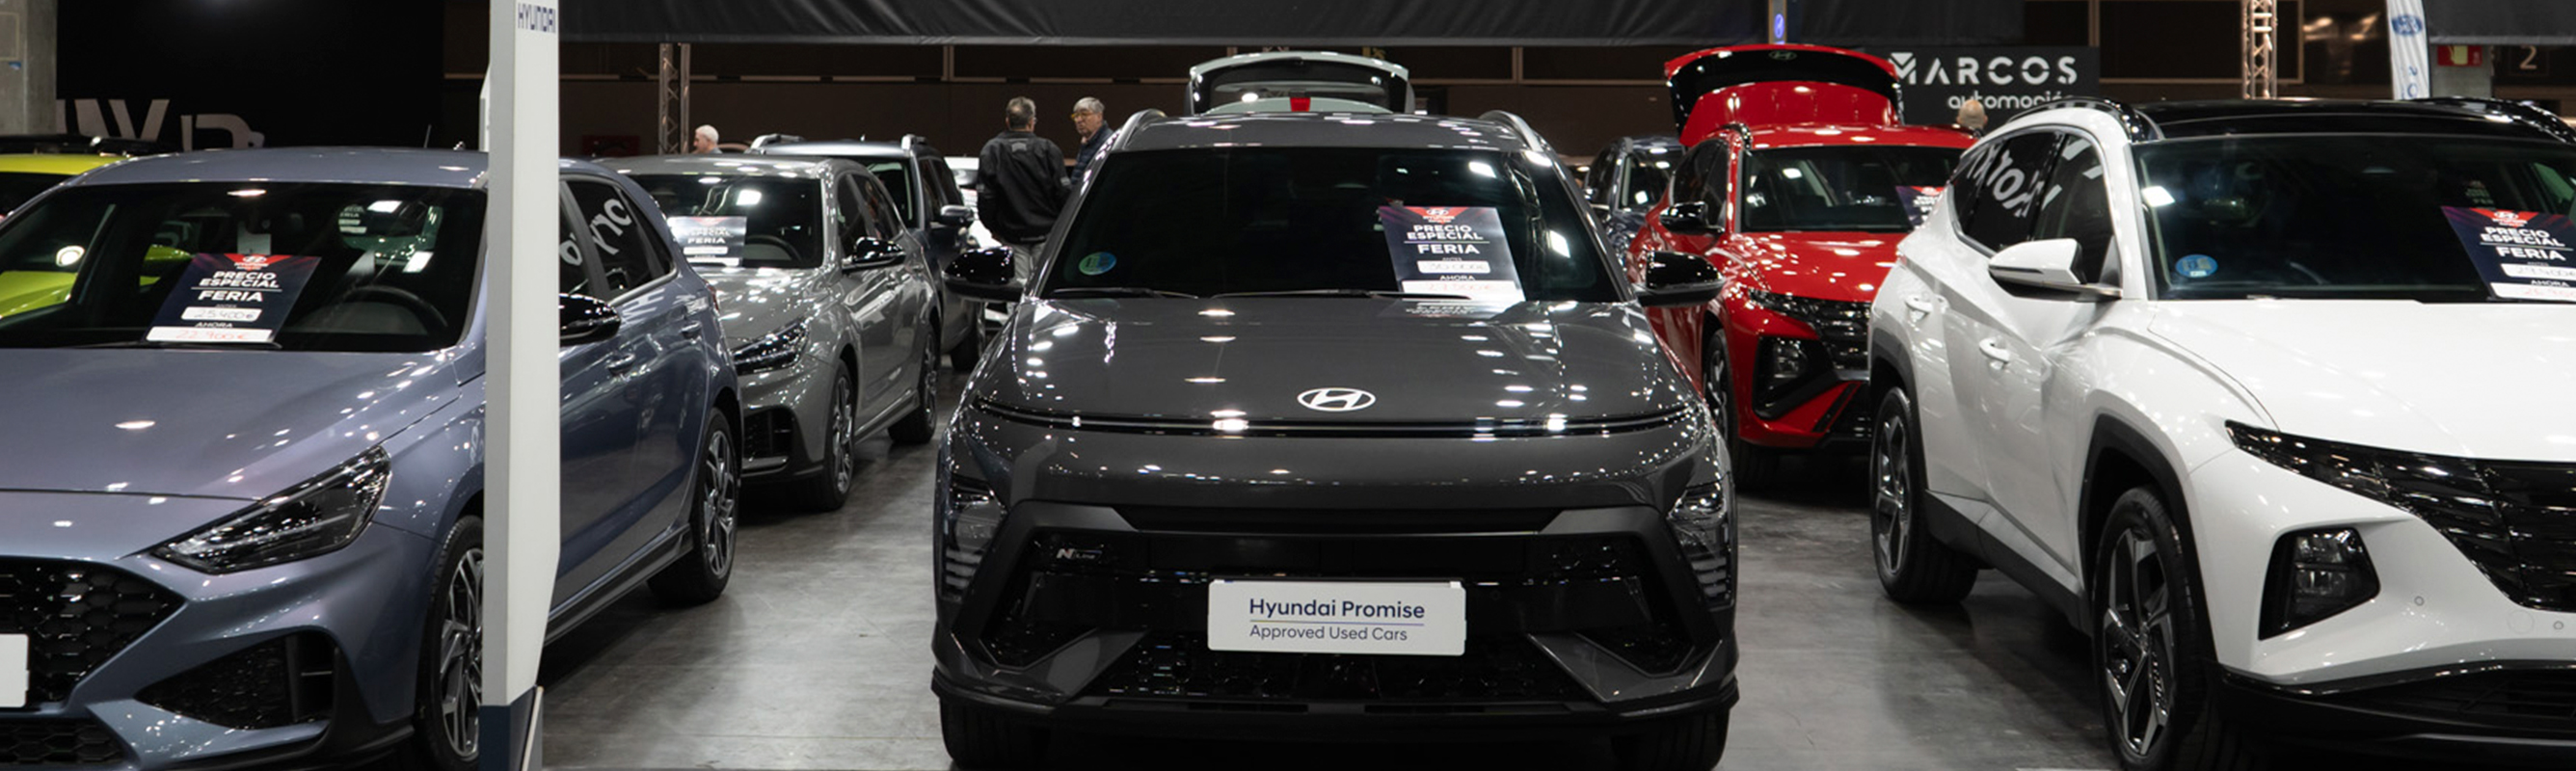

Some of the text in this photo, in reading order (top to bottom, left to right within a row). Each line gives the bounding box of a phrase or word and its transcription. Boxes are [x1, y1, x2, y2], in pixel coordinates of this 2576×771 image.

[518, 3, 556, 34] HYUNDAI
[2519, 45, 2537, 69] 2
[1889, 52, 2078, 85] MARCOS
[2484, 226, 2551, 238] PRECIO
[2480, 233, 2565, 247] ESPECIAL
[1417, 244, 1480, 254] FERIA
[2496, 247, 2566, 261] FERIA
[213, 271, 277, 280] PRECIO
[199, 278, 280, 288] ESPECIAL
[198, 291, 263, 302] FERIA
[1249, 598, 1425, 619] Hyundai Promise
[1249, 625, 1408, 641] Approved Used Cars
